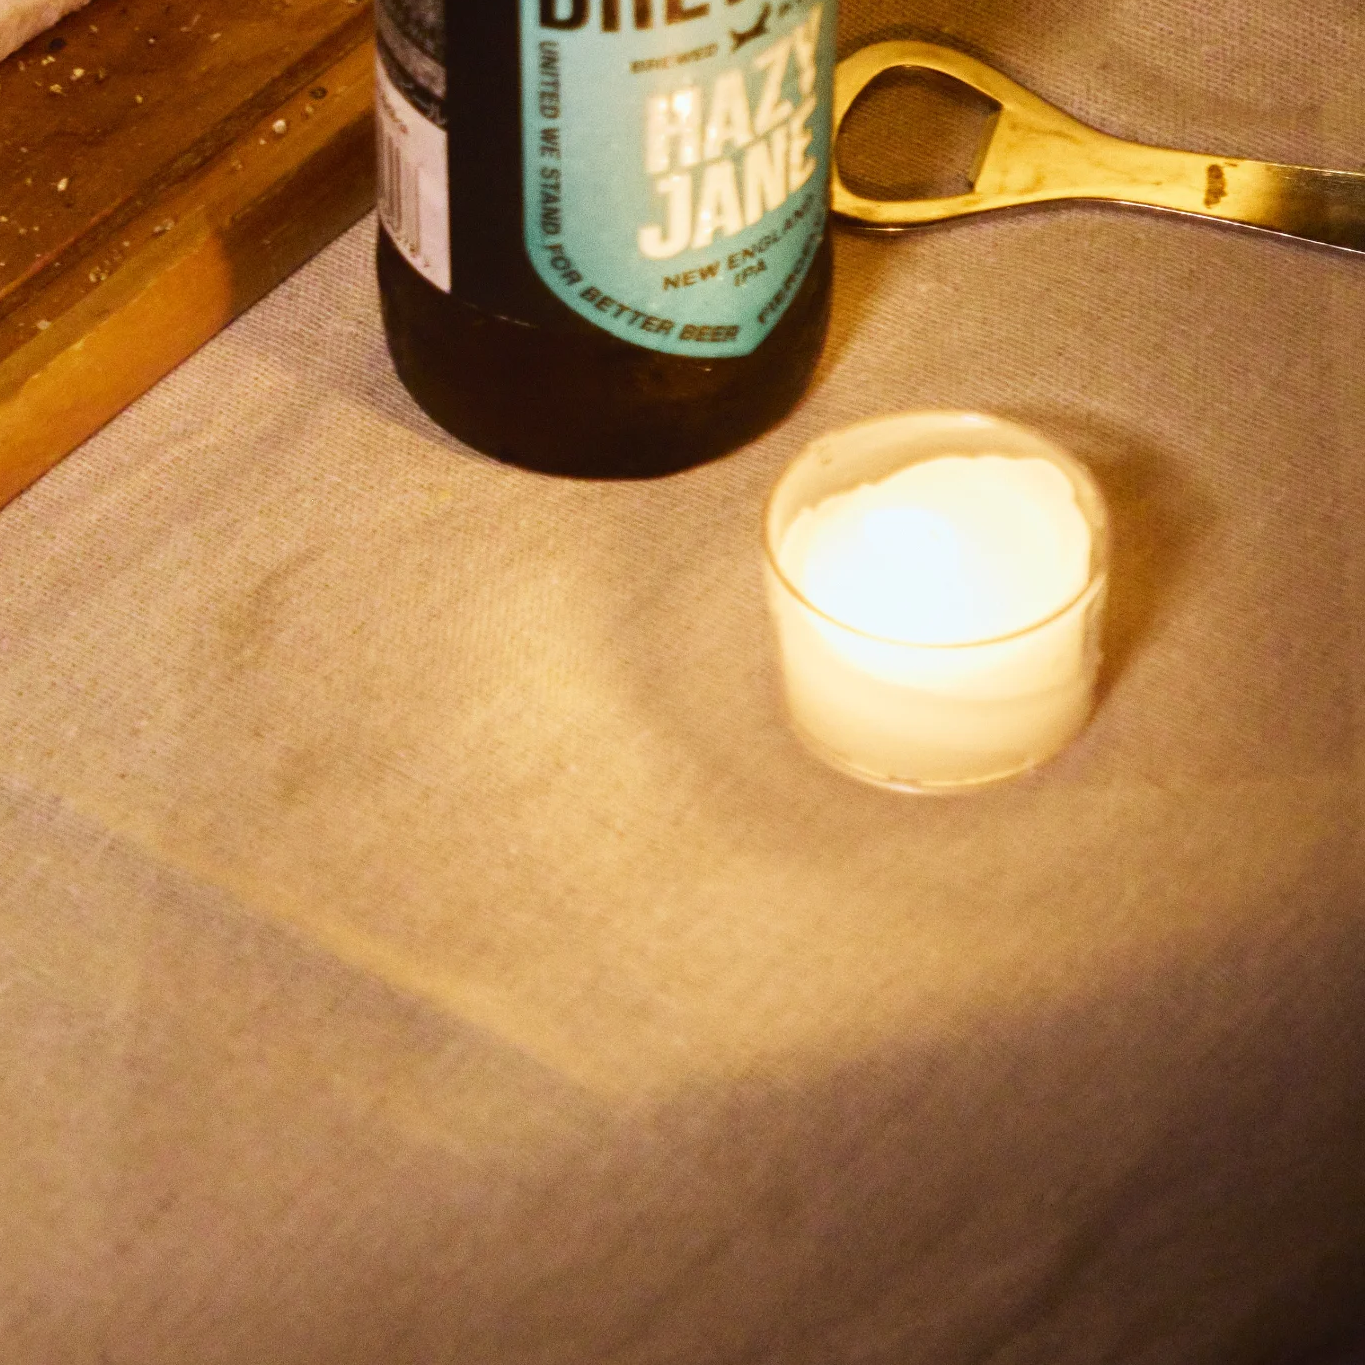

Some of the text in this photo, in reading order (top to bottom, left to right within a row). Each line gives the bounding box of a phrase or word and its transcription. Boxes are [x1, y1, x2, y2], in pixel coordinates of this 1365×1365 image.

[644, 1, 822, 174] HAZY
[538, 40, 740, 343] UNITED WE STAND FOR BETTER BEER
[637, 94, 817, 261] JANE
[662, 260, 721, 291] NEW
